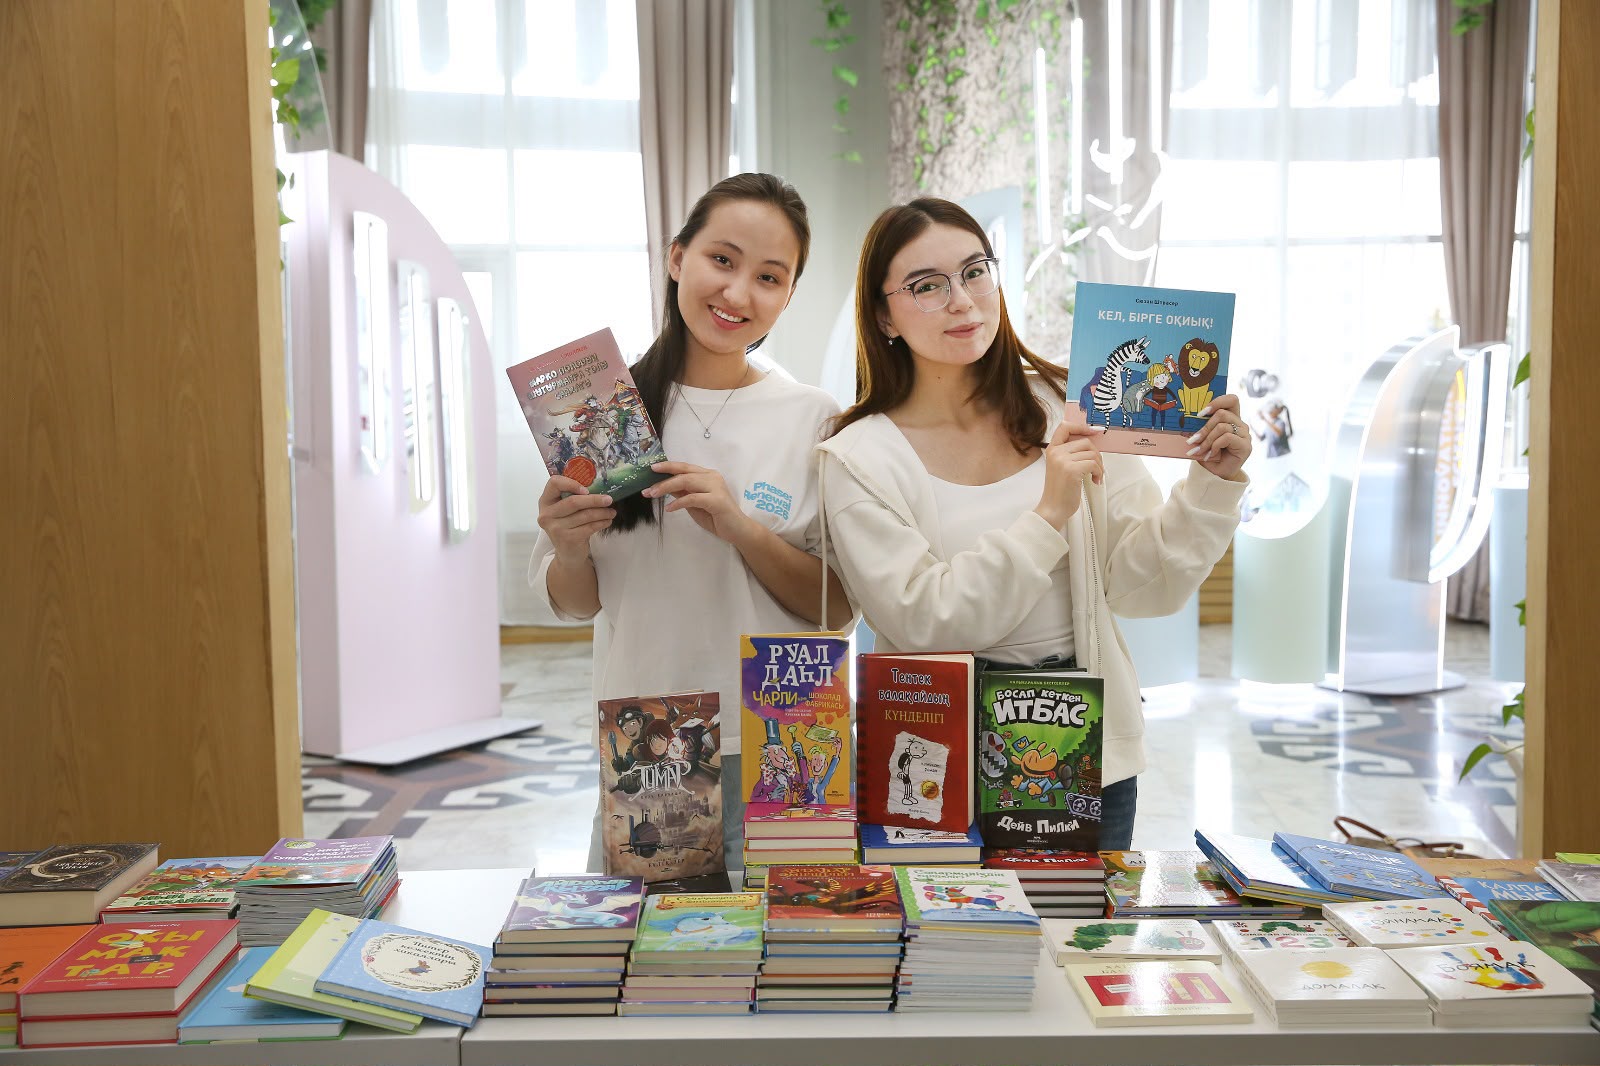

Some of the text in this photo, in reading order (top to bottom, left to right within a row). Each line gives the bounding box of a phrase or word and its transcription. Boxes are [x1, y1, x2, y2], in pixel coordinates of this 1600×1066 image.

[1098, 310, 1214, 330] КЕЛ, БІРГЕ ОҚИЫҚ!
[768, 643, 830, 665] РУАЛ
[891, 668, 932, 685] Тентек
[752, 690, 798, 707] ЧАРЛИ
[805, 700, 844, 710] ФАБРИКАСЫ
[808, 692, 841, 701] ШОКОЛАД
[878, 689, 950, 707] балақайдың
[885, 709, 945, 724] КҮНДЕЛІГІ
[993, 698, 1088, 726] ИТБАС
[997, 815, 1080, 833] Дейв Пилки
[413, 941, 450, 954] Питер
